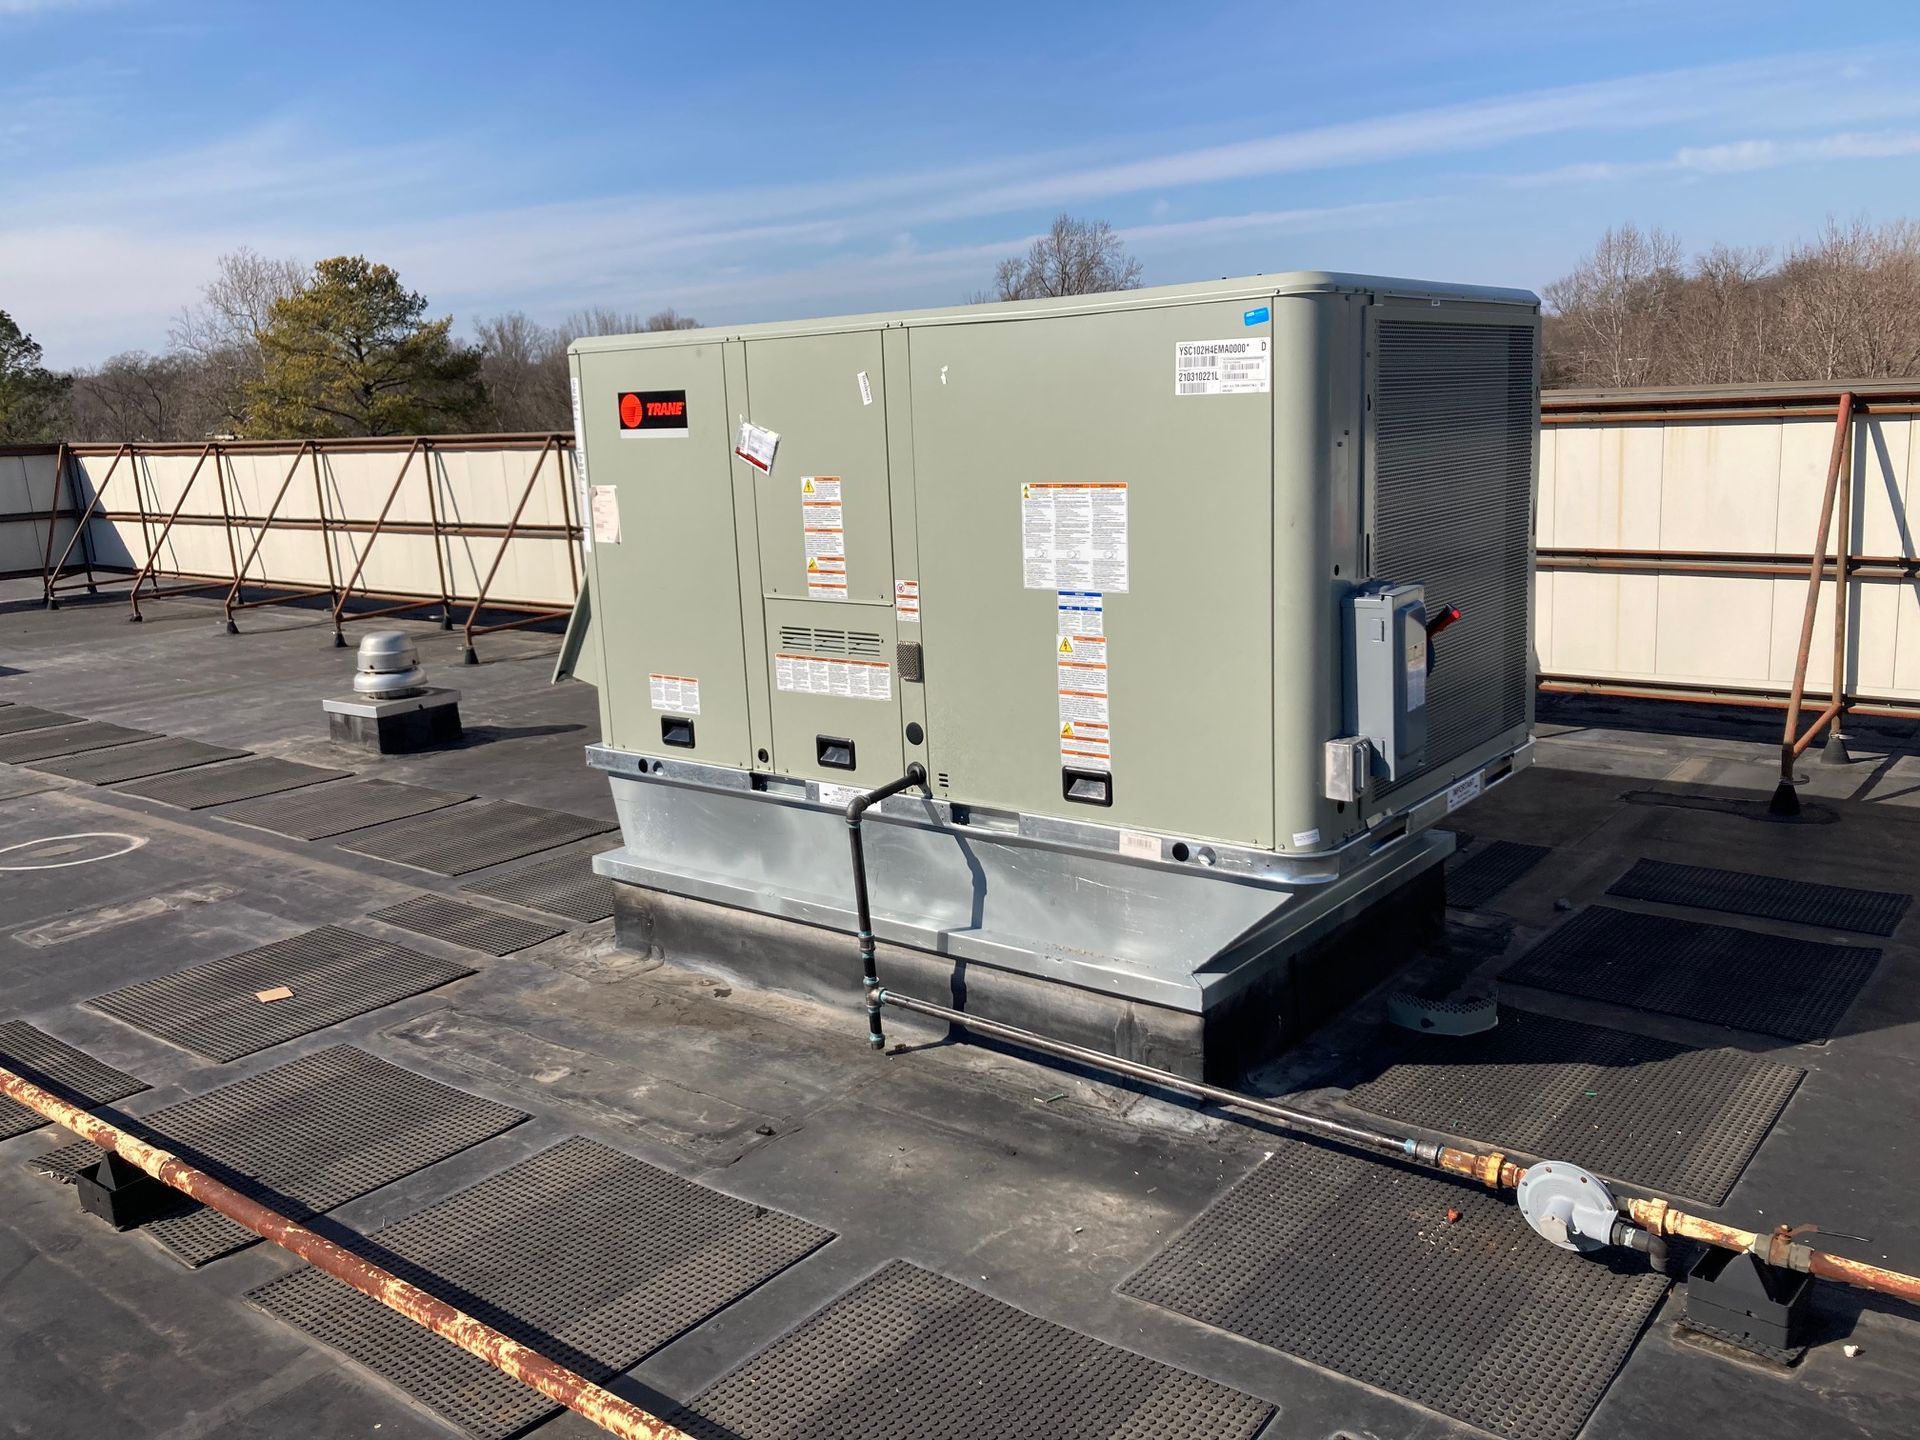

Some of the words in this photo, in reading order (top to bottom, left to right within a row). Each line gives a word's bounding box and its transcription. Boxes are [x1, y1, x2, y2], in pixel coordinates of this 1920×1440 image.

[1261, 341, 1267, 351] D
[1178, 371, 1219, 382] 210310221L
[646, 401, 683, 416] TRANE
